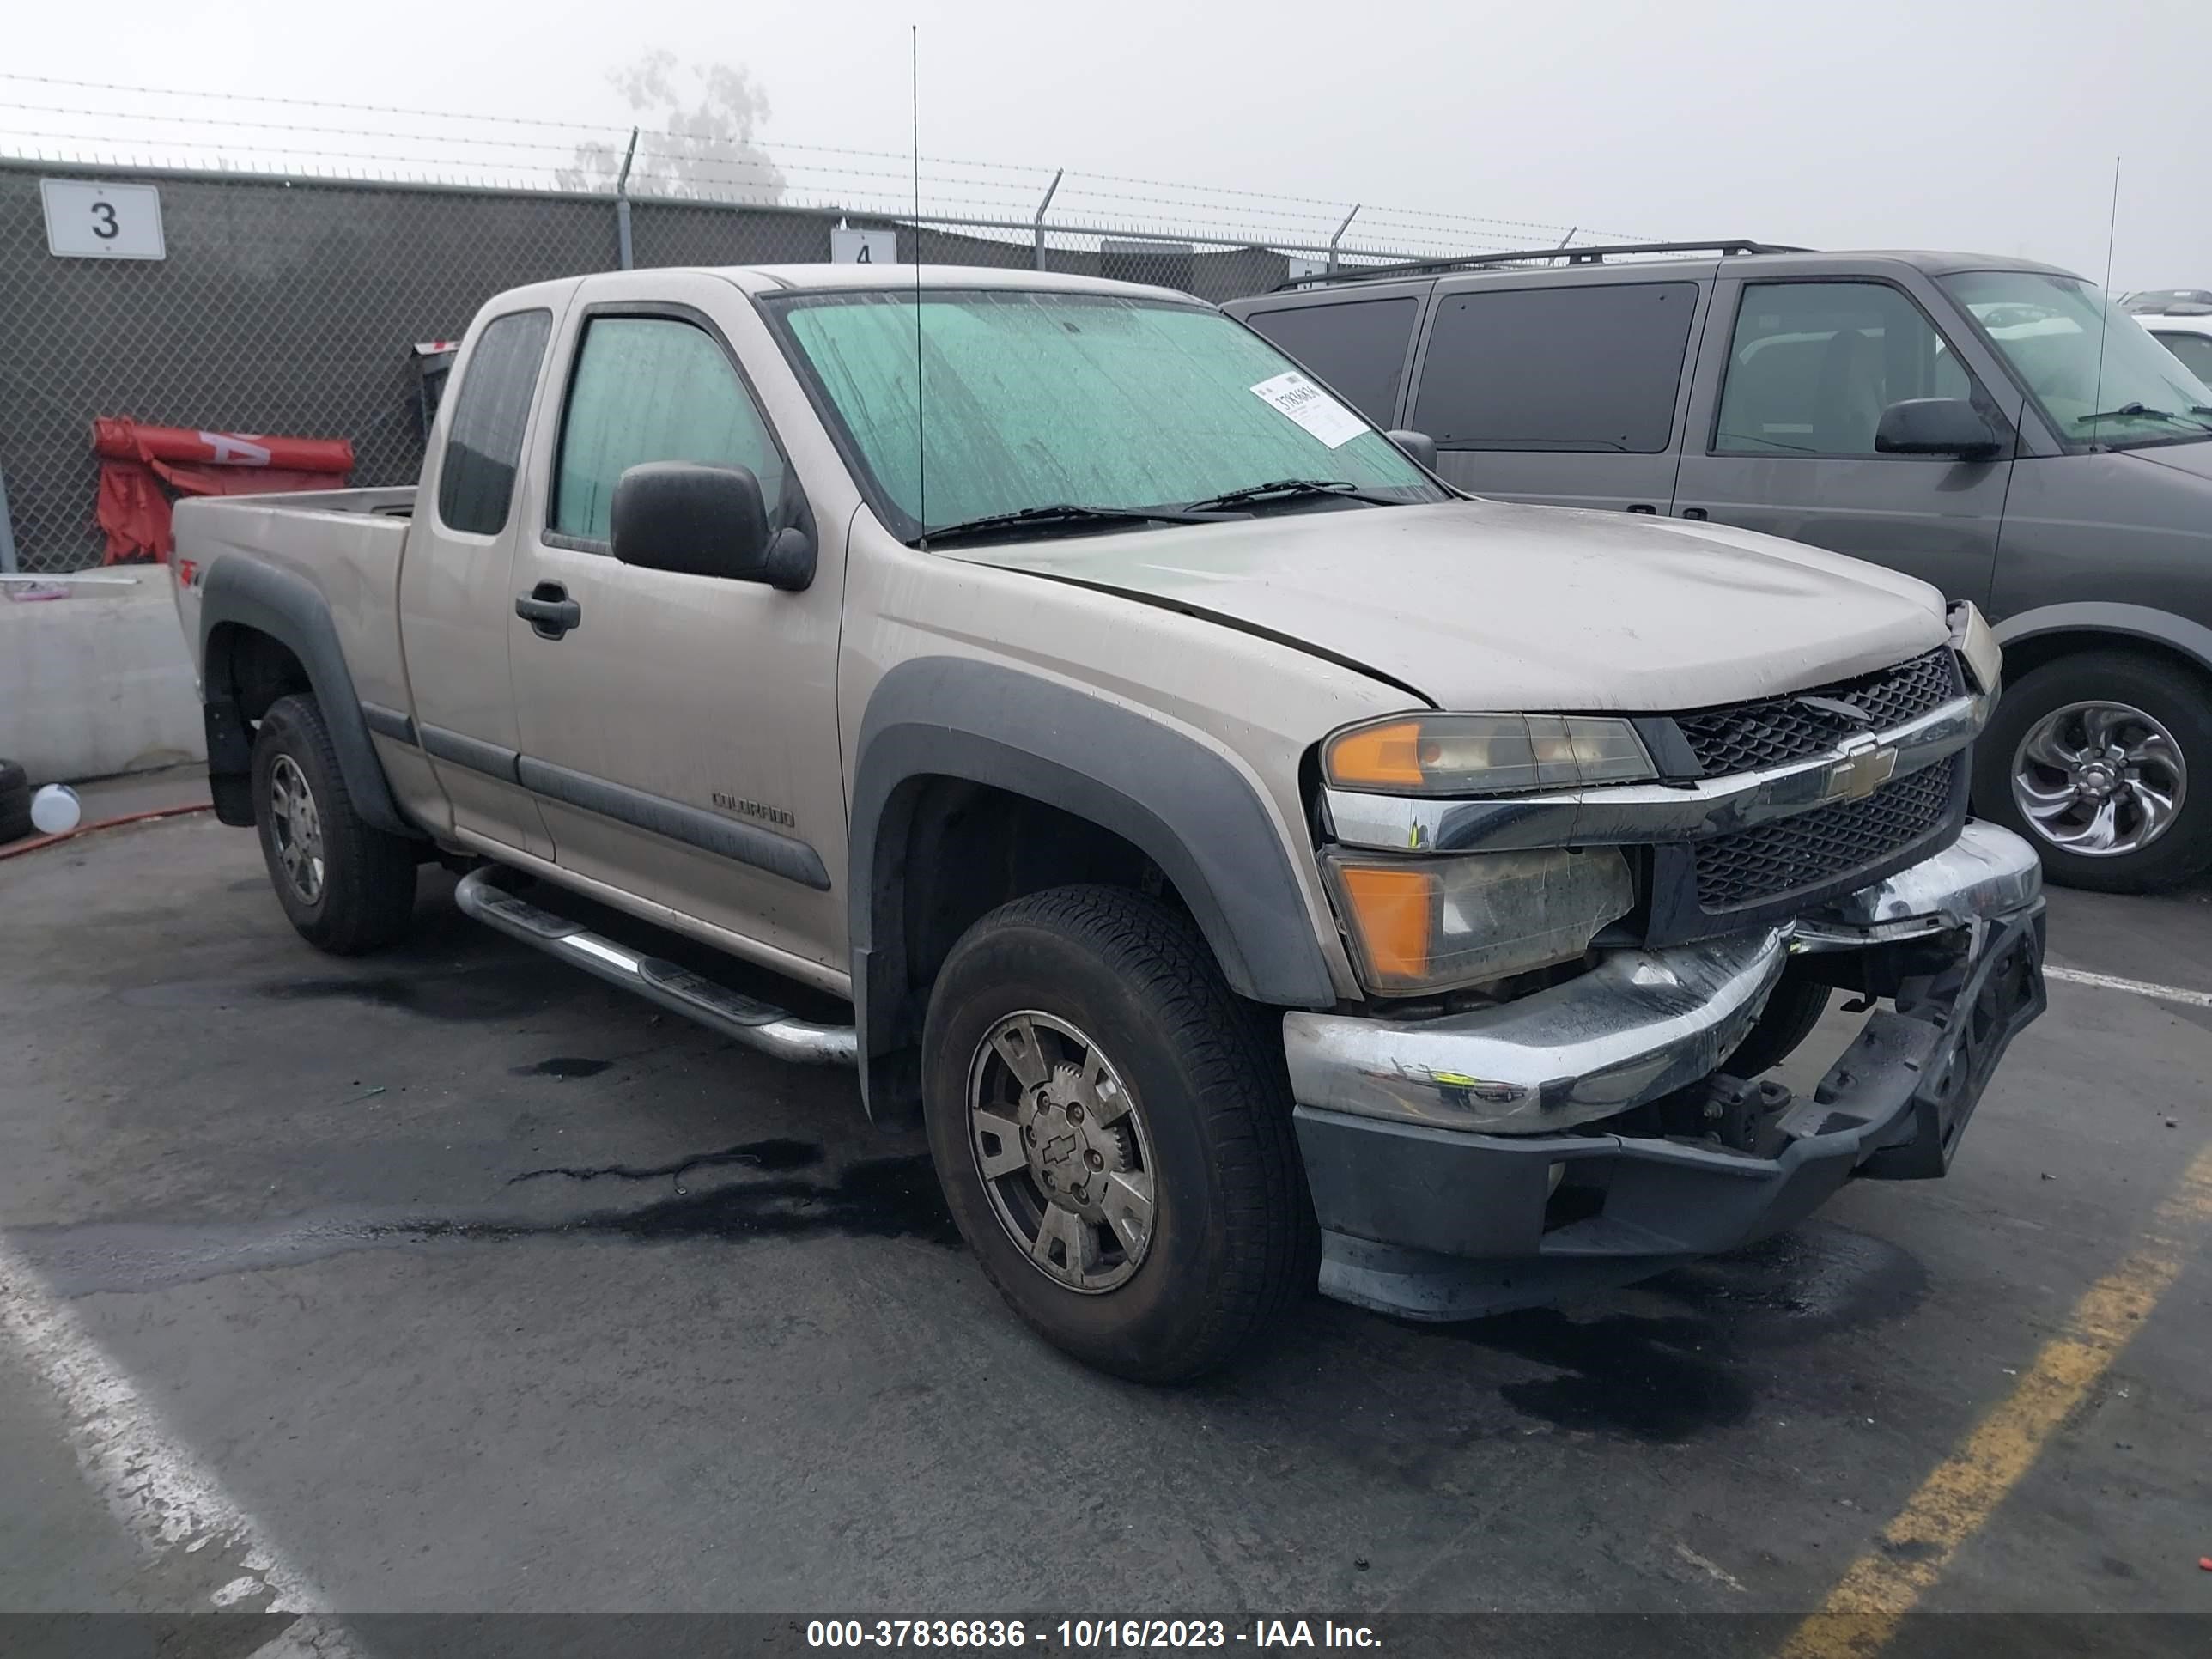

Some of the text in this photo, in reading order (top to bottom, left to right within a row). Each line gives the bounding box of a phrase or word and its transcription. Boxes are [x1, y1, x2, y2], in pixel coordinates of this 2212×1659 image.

[90, 201, 120, 240] 3
[856, 244, 872, 264] 4
[712, 792, 795, 828] COLORADO
